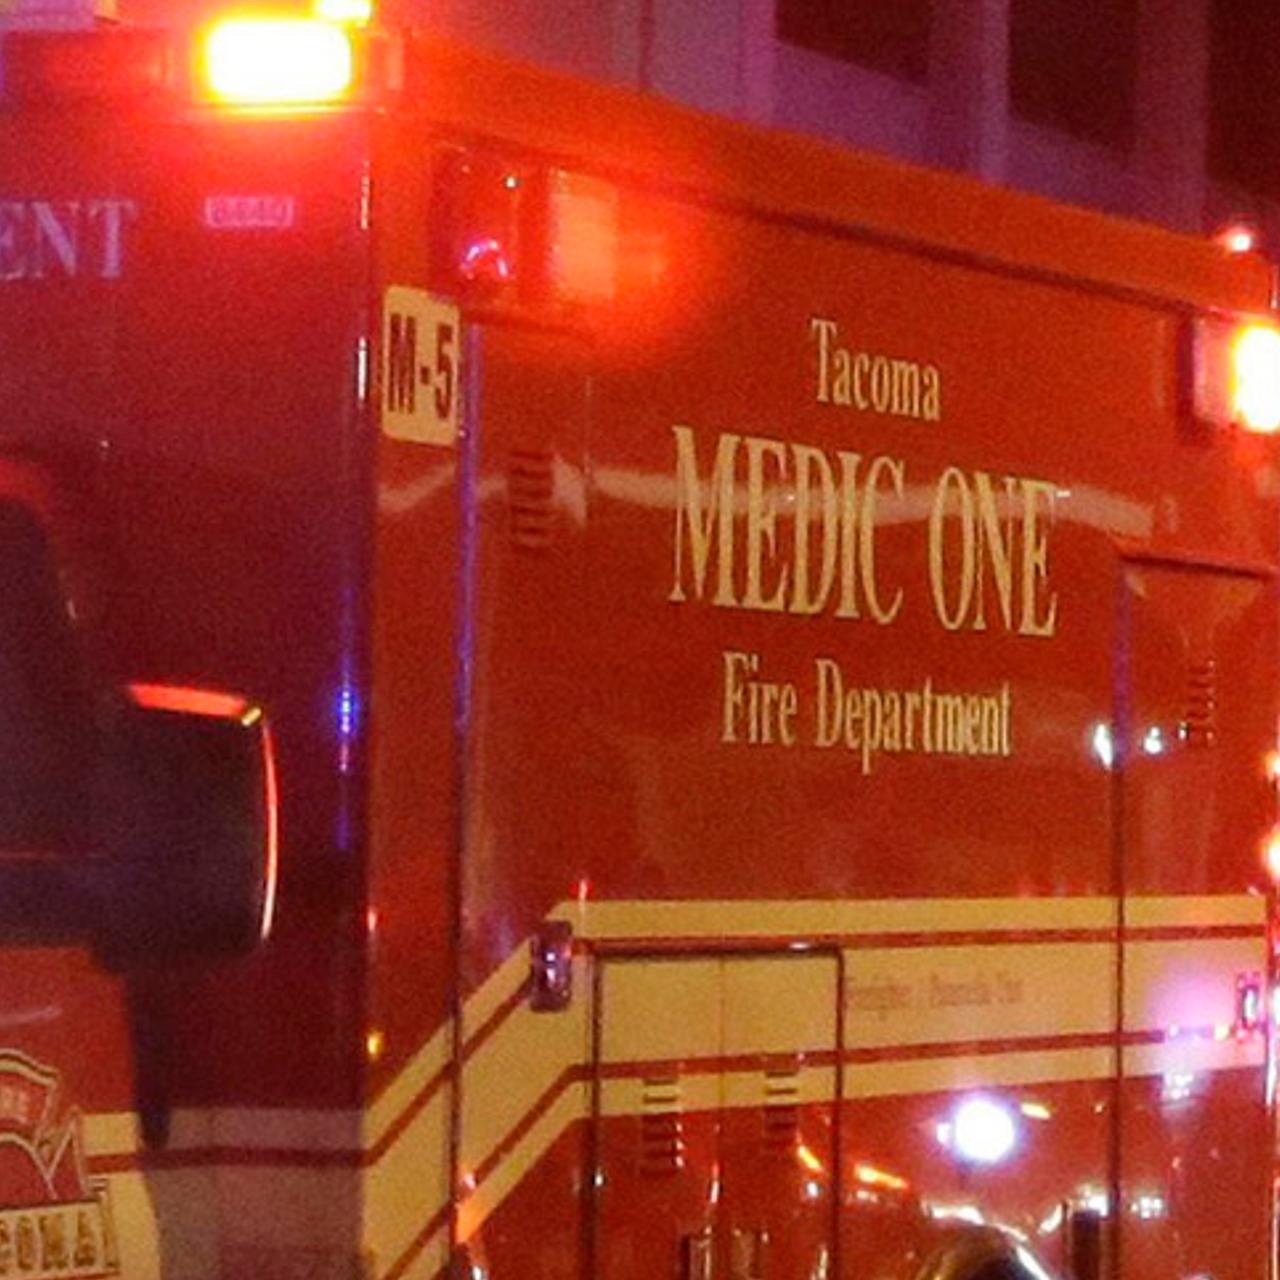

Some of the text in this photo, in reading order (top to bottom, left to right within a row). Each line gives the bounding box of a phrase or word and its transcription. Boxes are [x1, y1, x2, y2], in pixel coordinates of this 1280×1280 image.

[388, 312, 453, 419] M-5
[810, 317, 941, 421] Tacoma
[668, 424, 1060, 637] MEDIC ONE
[721, 650, 1011, 776] Fire Department
